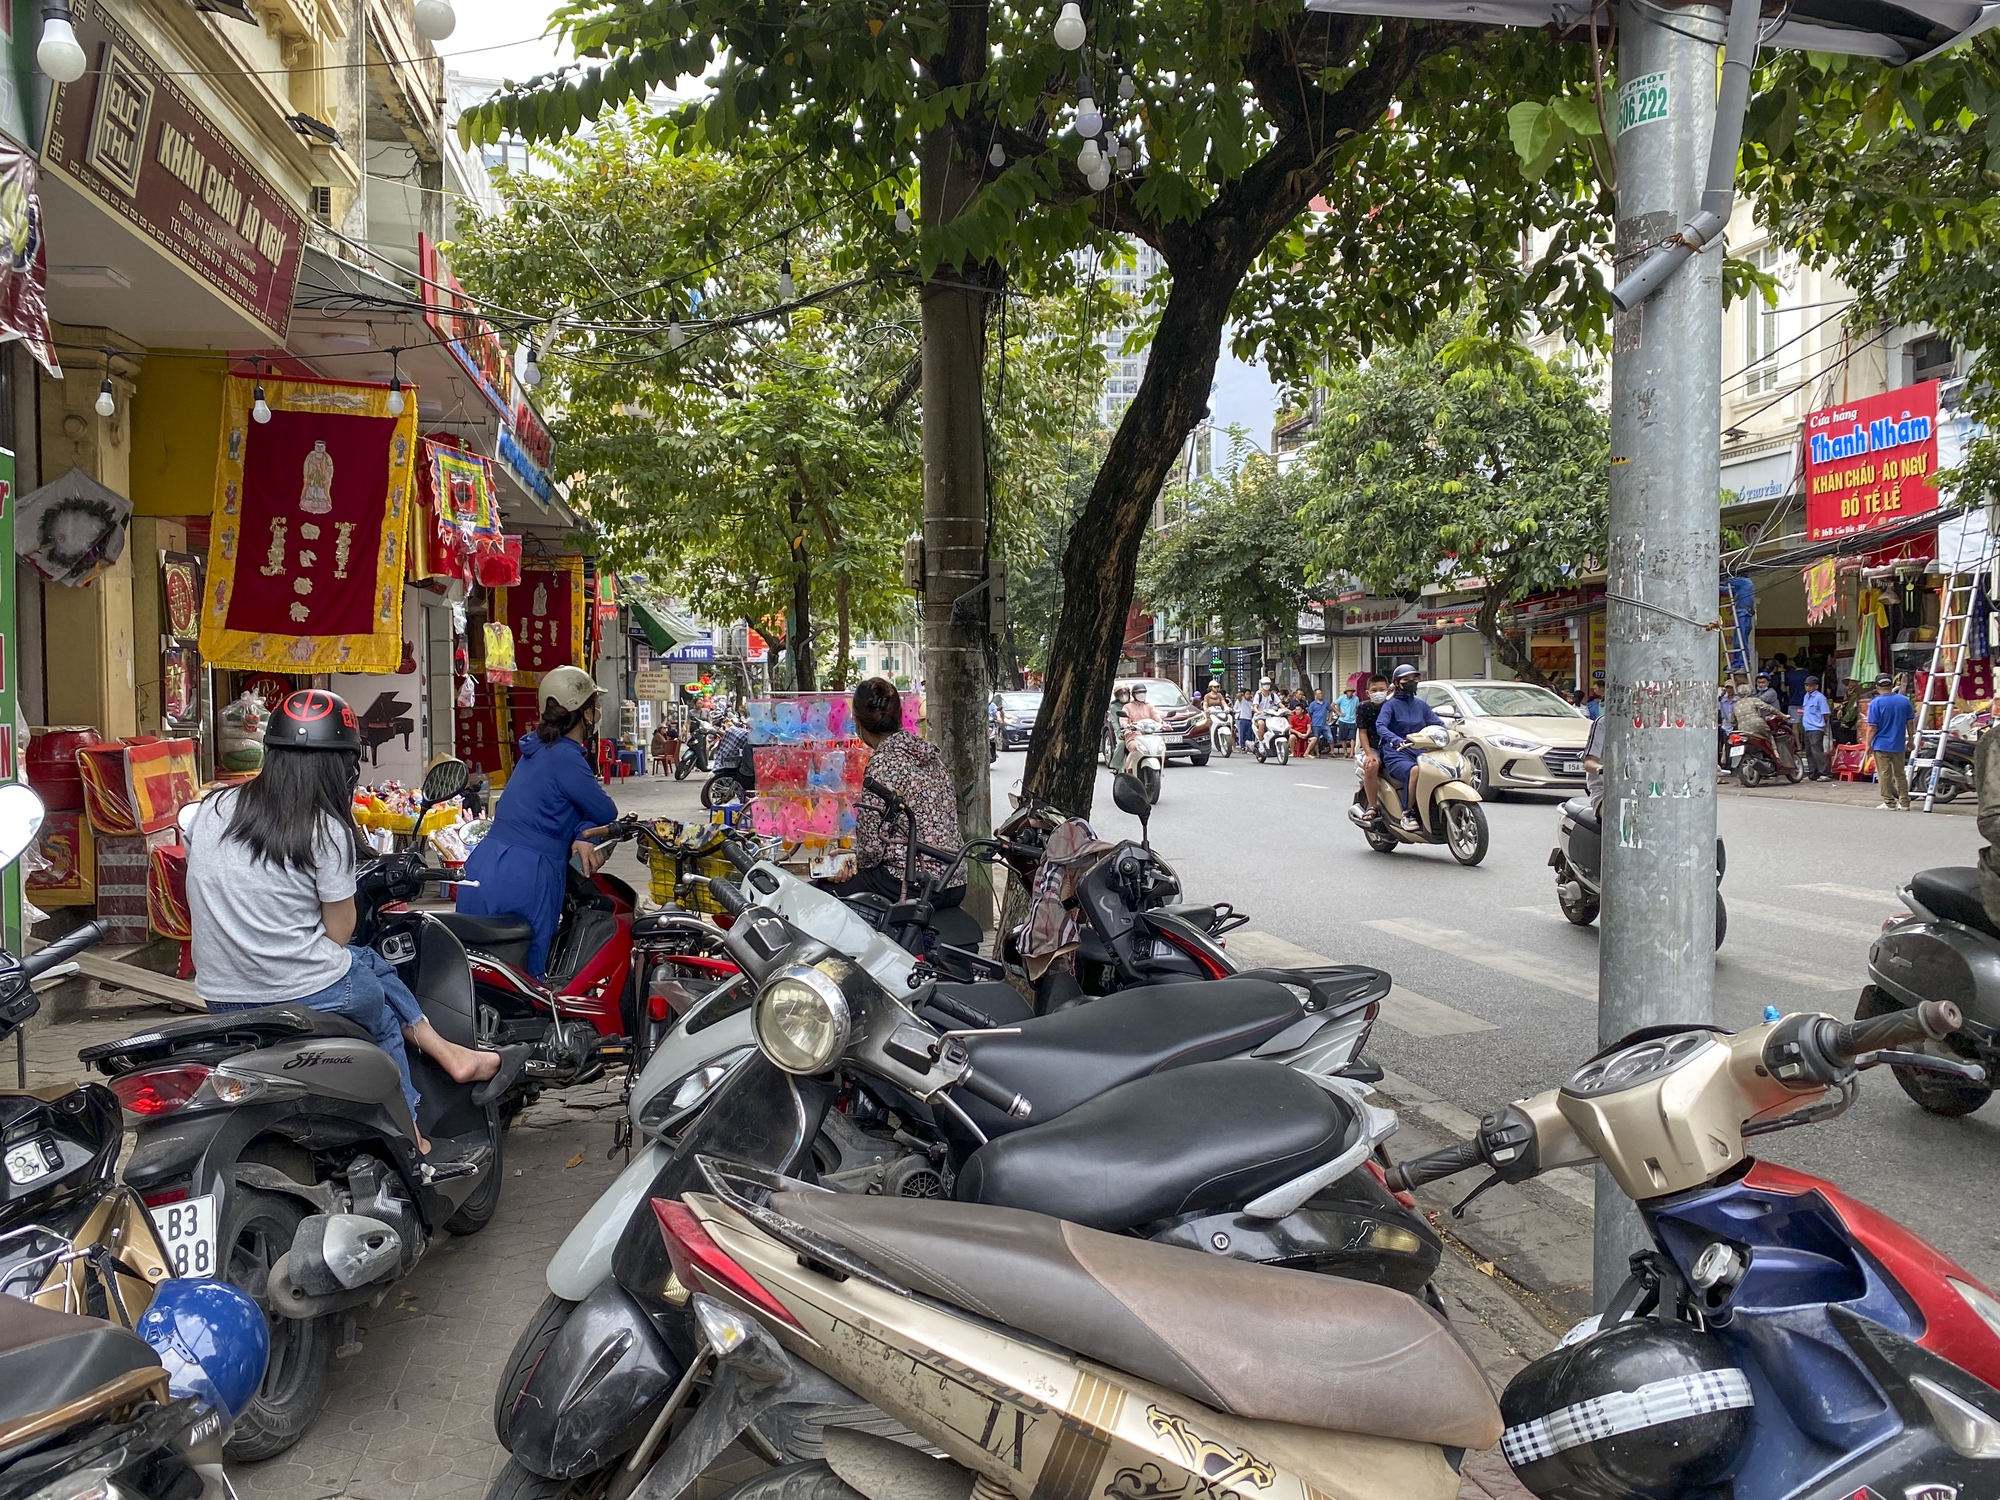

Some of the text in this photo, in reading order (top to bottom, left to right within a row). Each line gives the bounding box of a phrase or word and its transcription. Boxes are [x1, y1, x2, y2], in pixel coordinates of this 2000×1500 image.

[159, 121, 288, 274] KHĂN CHẦU ÁO NGỰ
[193, 212, 205, 231] 147
[183, 228, 199, 250] 0904
[1833, 408, 1859, 423] hàng
[1811, 424, 1868, 464] Thanh
[1869, 411, 1931, 452] Nhâm
[1813, 469, 1844, 495] KHĂN
[1882, 457, 1899, 482] ÁO
[1901, 452, 1929, 479] NGỰ
[1841, 490, 1860, 518] ĐỒ
[1864, 485, 1881, 514] TẾ
[1884, 481, 1902, 511] LỄ
[685, 646, 708, 658] TÍNH
[321, 1055, 355, 1065] mode
